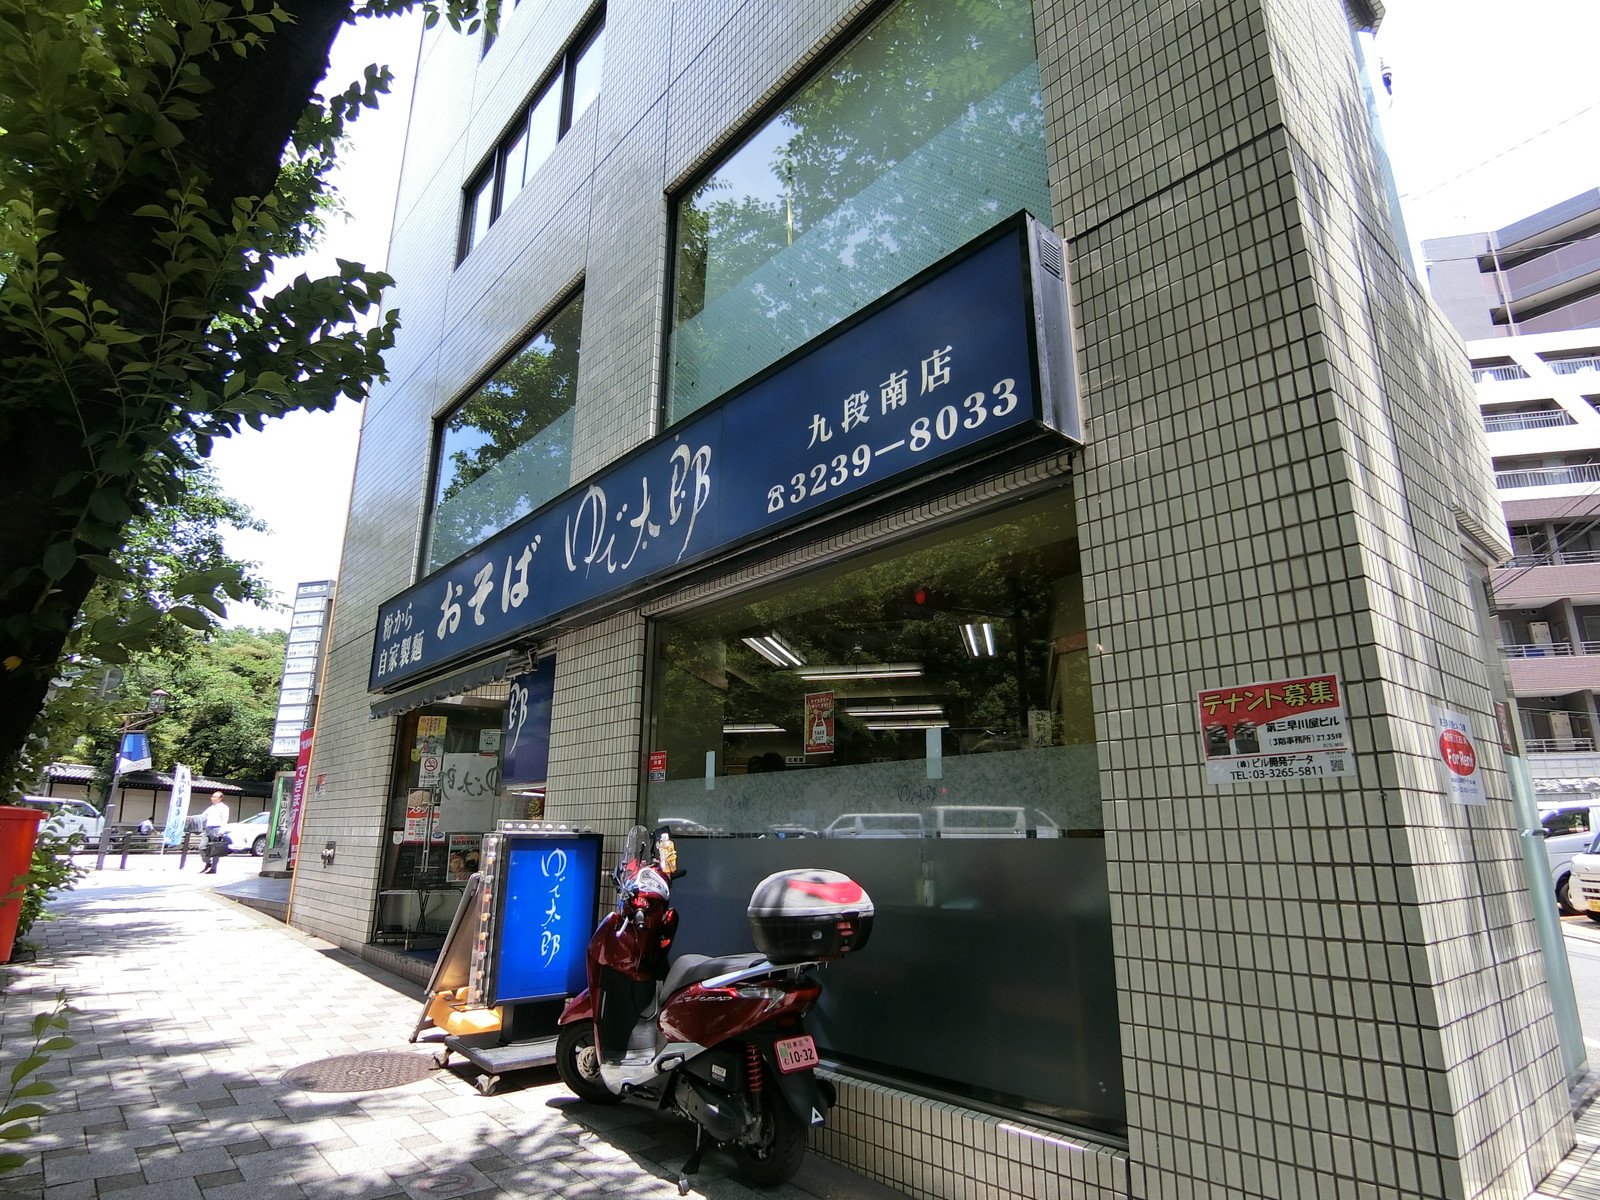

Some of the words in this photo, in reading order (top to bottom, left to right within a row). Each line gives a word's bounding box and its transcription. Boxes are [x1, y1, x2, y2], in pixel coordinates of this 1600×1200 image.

[806, 344, 953, 450] 九段南店
[565, 433, 712, 579] ゆで太郎
[437, 534, 542, 640] おそば
[382, 602, 413, 642] 粉から
[1202, 680, 1335, 716] テナント募集
[1265, 716, 1340, 733] 第三早川屋ビル
[1230, 765, 1324, 781] TEL:03-3265-5811
[1236, 754, 1314, 769] (株)ビル開発データ
[408, 806, 429, 814] スタッ
[540, 848, 567, 969] ゆで太郎
